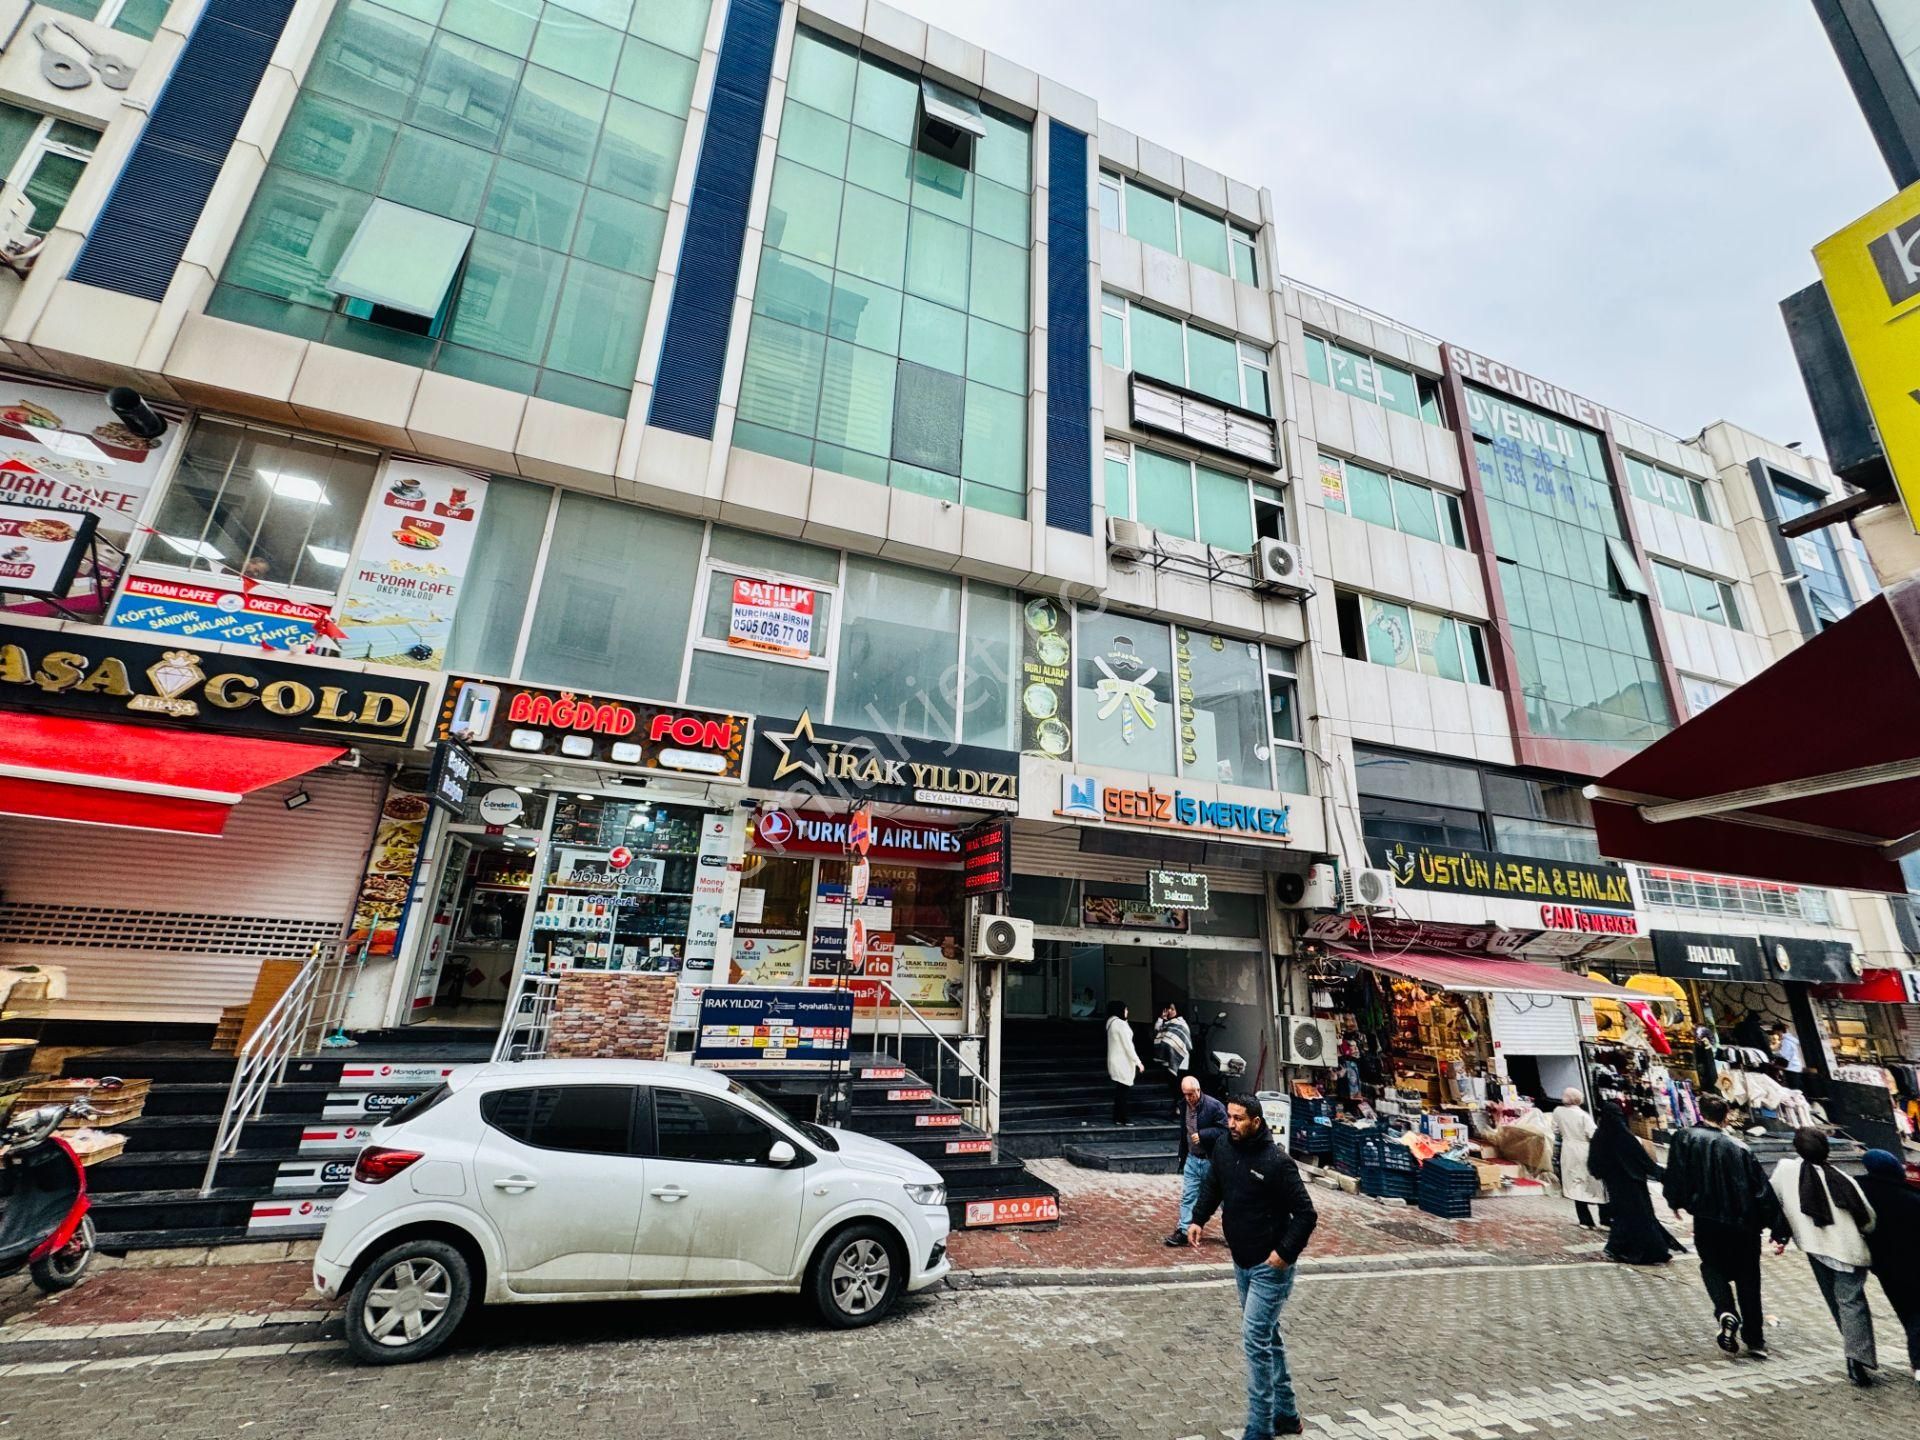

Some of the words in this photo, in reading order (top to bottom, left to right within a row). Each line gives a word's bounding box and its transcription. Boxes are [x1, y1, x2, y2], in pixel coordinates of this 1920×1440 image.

[1504, 462, 1526, 488] 533
[61, 484, 140, 513] CAFE
[416, 519, 432, 529] TOST
[131, 580, 176, 597] MEYDAN
[178, 588, 215, 603] CAFFE
[358, 570, 417, 590] MEYDAN
[419, 580, 457, 596] CAFE
[738, 580, 810, 605] SATILIK
[249, 599, 282, 613] OKEY
[752, 597, 772, 608] FOR
[773, 600, 798, 609] SALE
[117, 606, 167, 625] KÖFTE
[148, 610, 201, 630] SANDVİÇ
[734, 607, 781, 620] NURCİHAN
[783, 613, 810, 626] BİRSİN
[182, 615, 239, 636] BAKLAVA
[221, 621, 264, 640] TOST
[249, 625, 301, 644] KAHVE
[733, 619, 758, 632] 0505
[761, 621, 779, 636] 036
[782, 626, 794, 640] 77
[796, 629, 809, 643] 08
[284, 631, 316, 647] ÇA
[204, 673, 411, 728] GOLD
[508, 690, 636, 737] BAĞDAD
[650, 713, 732, 750] FON
[824, 745, 907, 786] İRAK
[910, 762, 1018, 799] YILDIZI
[918, 790, 964, 805] SEYAHAT
[1103, 787, 1173, 820] GEDİZ
[1174, 790, 1197, 825] İŞ
[1199, 800, 1291, 837] MERKEZİ
[796, 819, 877, 845] TURKIH
[882, 826, 961, 853] AIRLINES
[700, 877, 725, 886] Money
[1419, 847, 1489, 889] ÜSTÜN
[1494, 860, 1552, 895] ARSA
[1551, 867, 1567, 895] &
[1568, 870, 1632, 903] EMLAK
[696, 885, 724, 894] transfe
[1541, 904, 1576, 929] CAN
[697, 930, 714, 938] Para
[875, 943, 894, 951] UPT
[1687, 945, 1741, 966] HALHAL
[868, 957, 889, 973] ria
[704, 999, 729, 1008] IRAK
[729, 999, 763, 1009] YILDIZI
[393, 1068, 436, 1076] MoneyGram
[1035, 1199, 1057, 1218] ria
